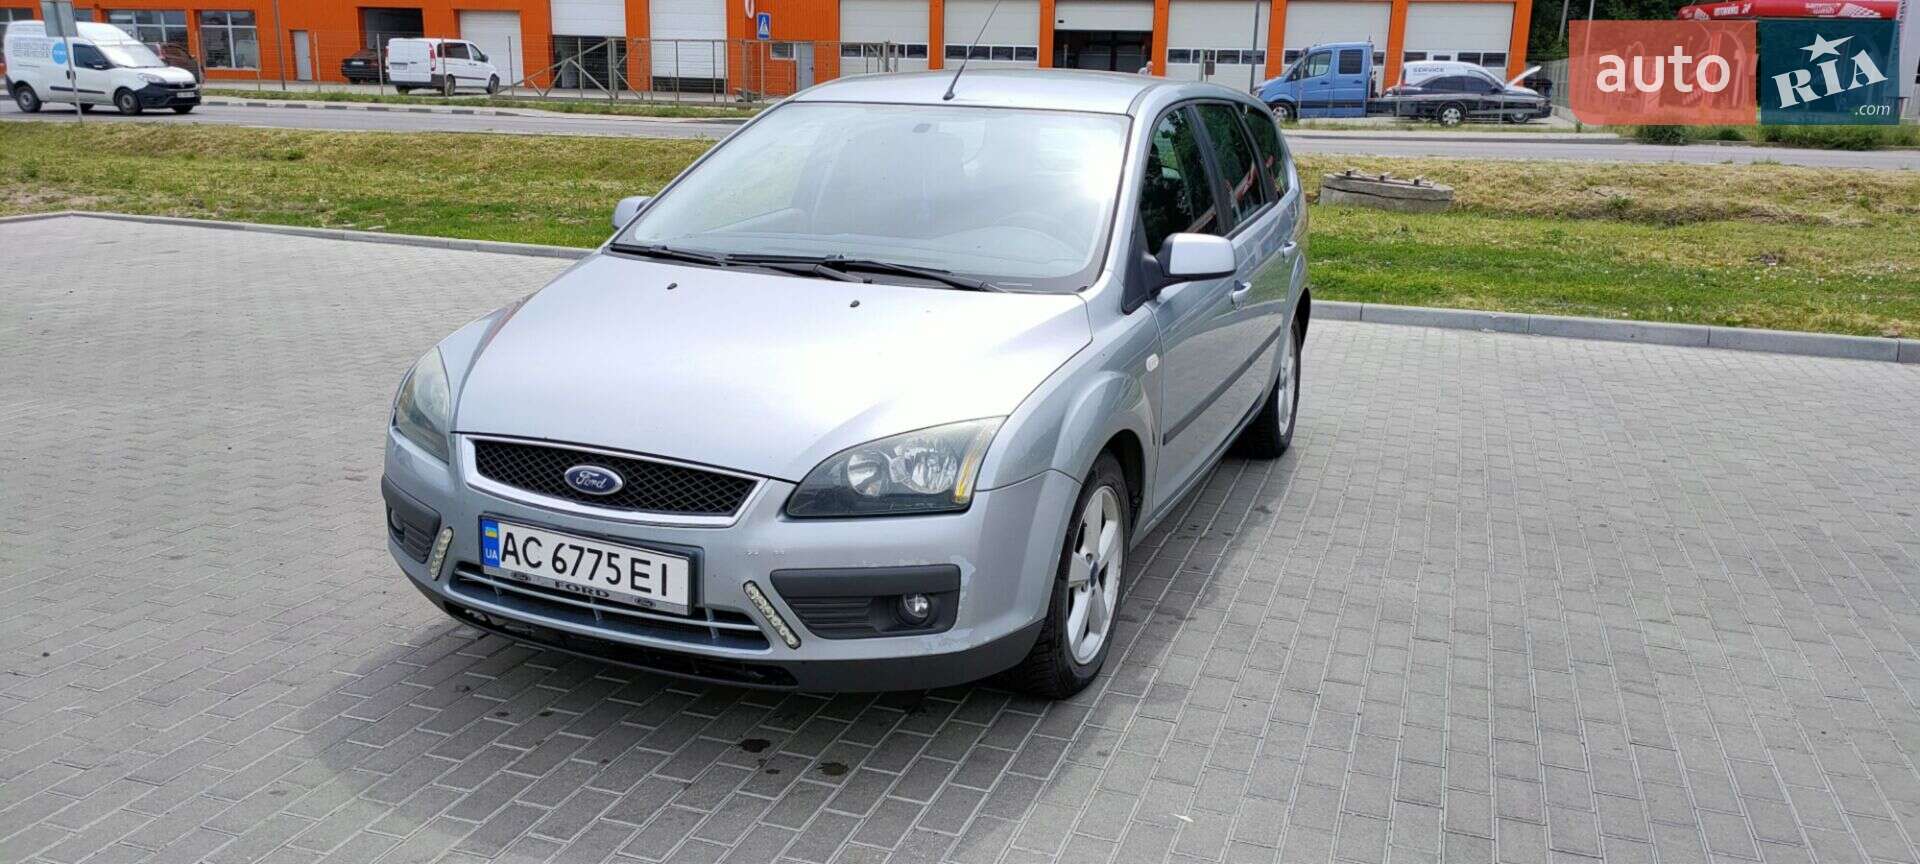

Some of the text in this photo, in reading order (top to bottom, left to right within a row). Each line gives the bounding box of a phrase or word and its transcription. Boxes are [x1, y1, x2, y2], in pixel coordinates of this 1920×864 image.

[575, 470, 608, 489] Ford
[485, 547, 498, 561] UA
[501, 531, 668, 597] AC 6775 EI
[554, 580, 610, 599] FORD
